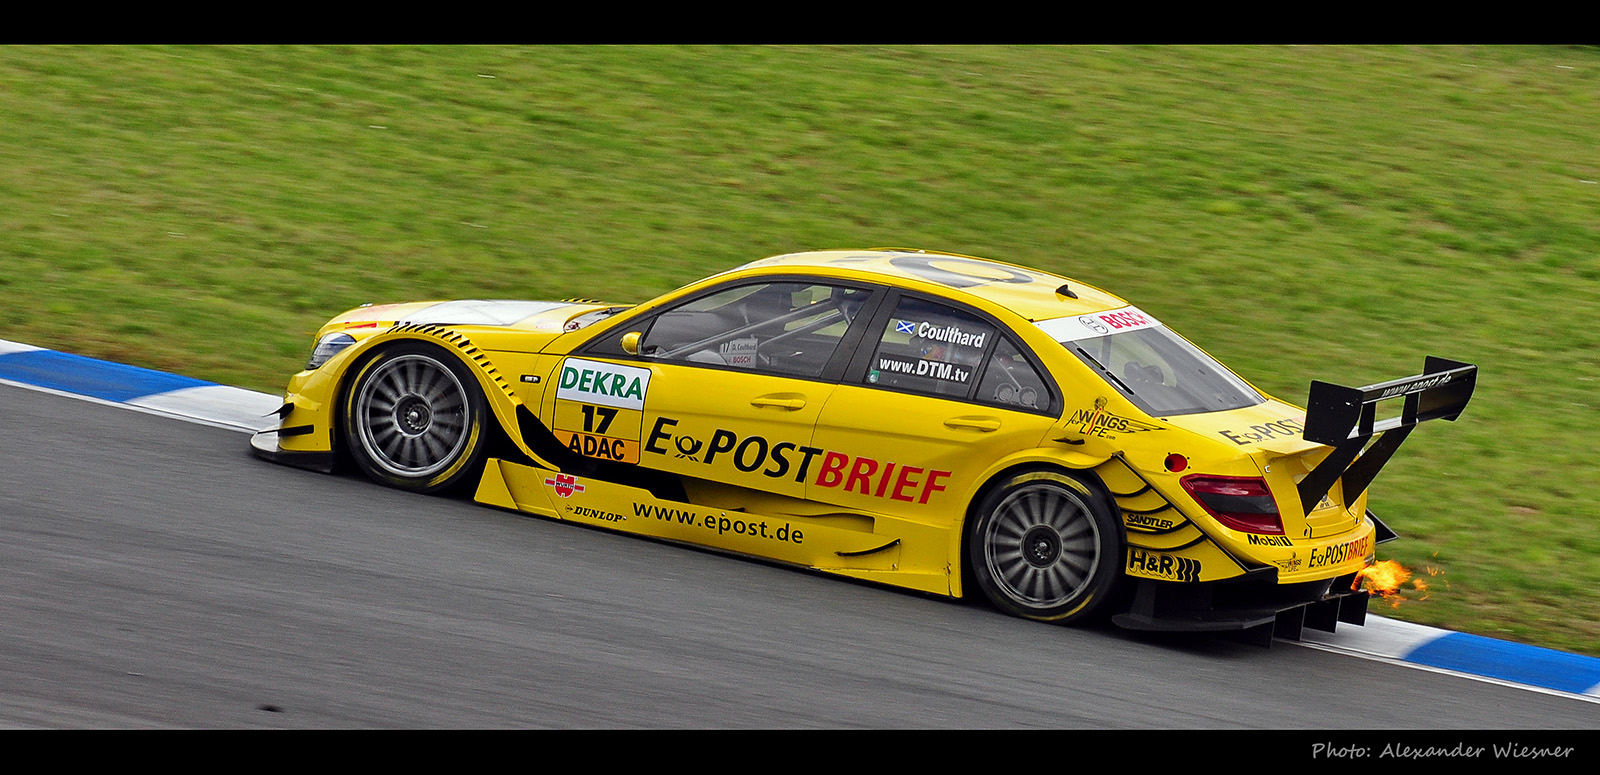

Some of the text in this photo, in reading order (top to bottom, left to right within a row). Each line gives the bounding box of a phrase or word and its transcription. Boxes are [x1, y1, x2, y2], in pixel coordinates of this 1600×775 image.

[1099, 310, 1153, 329] BOSCH
[918, 321, 986, 348] Coulthard
[733, 355, 751, 364] BOSCH
[880, 358, 969, 382] www.DTM.tv
[560, 366, 642, 400] DEKRA
[582, 404, 619, 434] 17
[1079, 409, 1129, 431] WINGS
[568, 433, 625, 460] ADAC
[573, 506, 623, 522] DUNLOP
[632, 502, 804, 544] www.epost.de
[1126, 513, 1174, 529] SANDTLER
[1129, 550, 1174, 576] H&R
